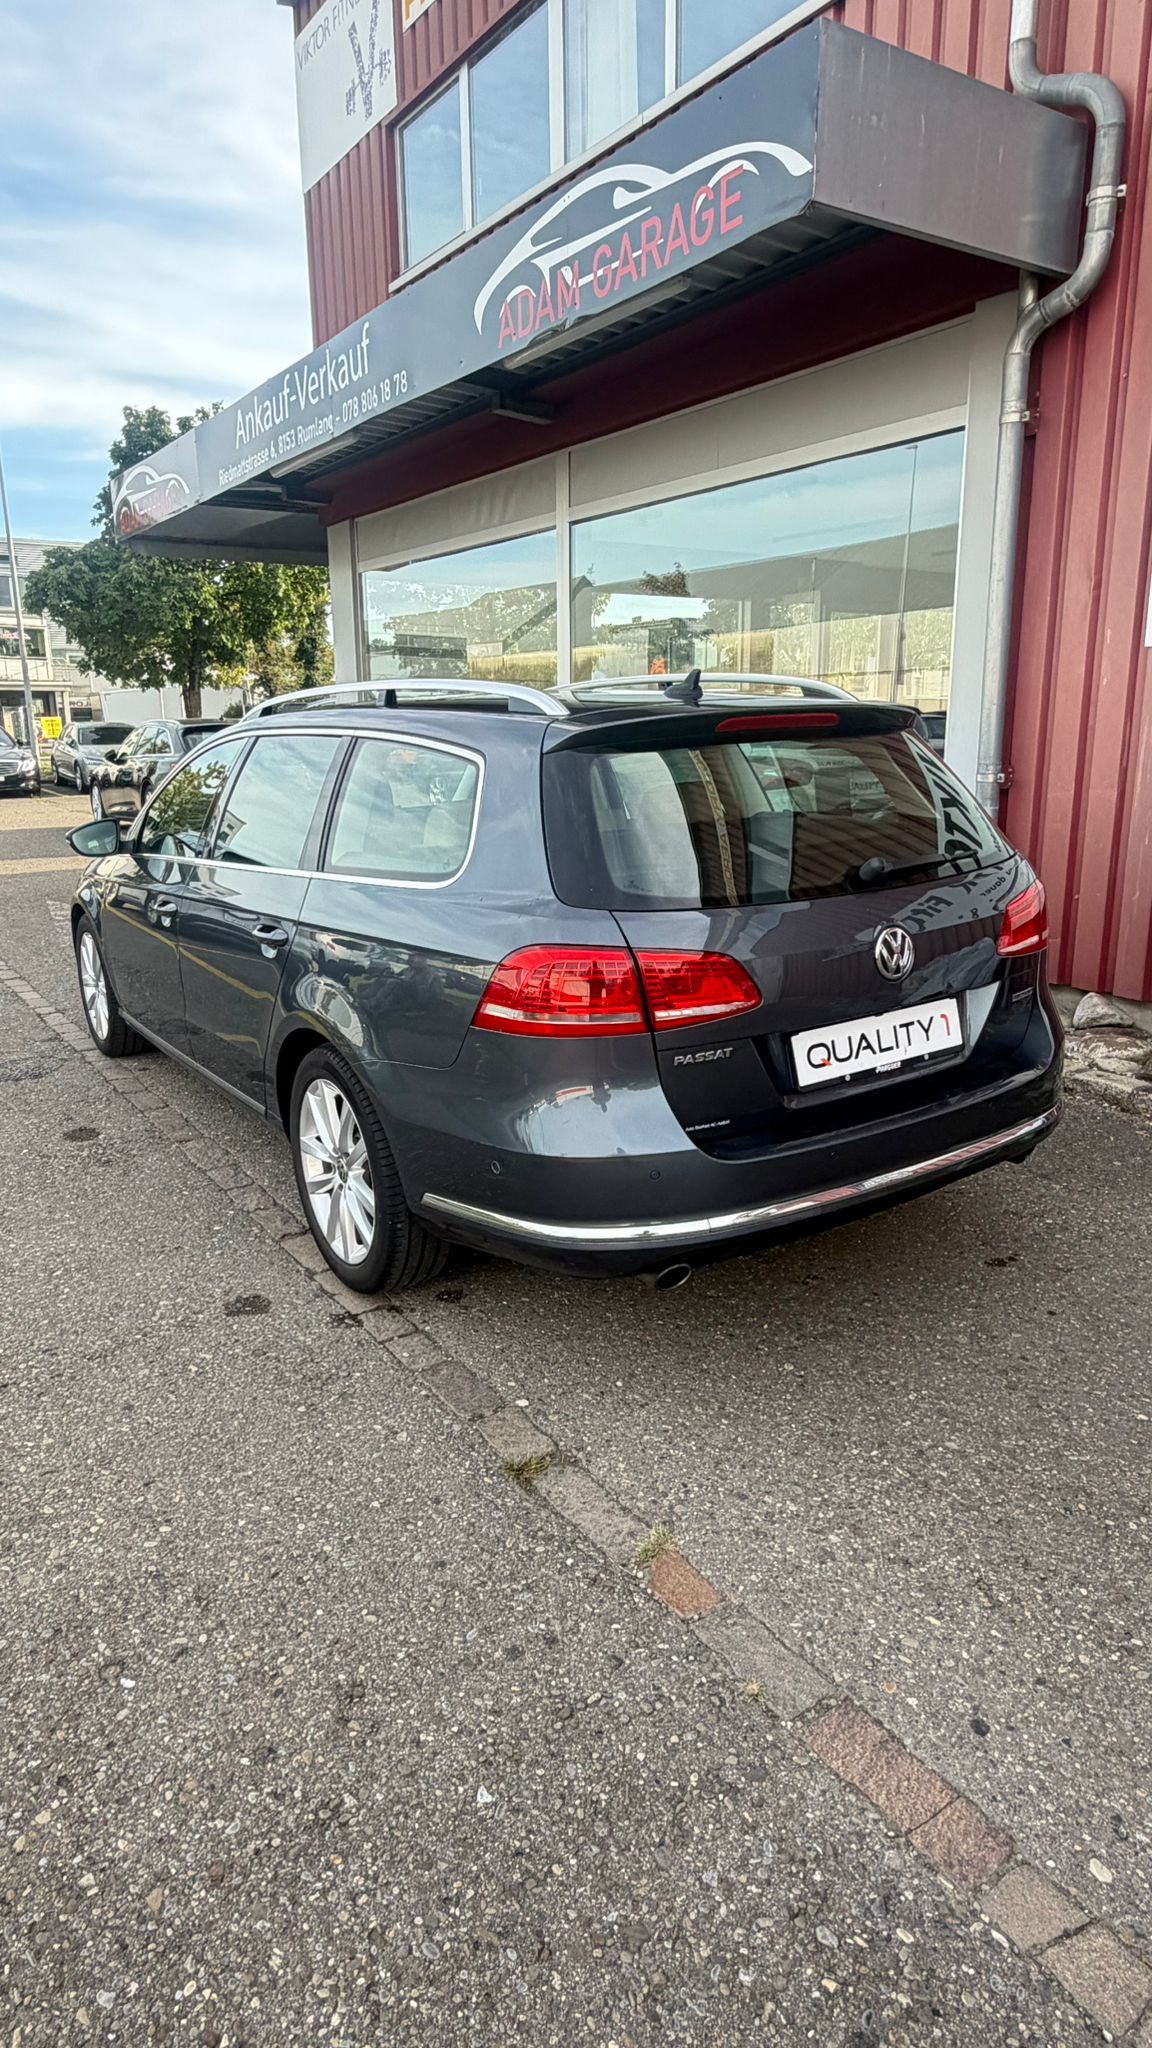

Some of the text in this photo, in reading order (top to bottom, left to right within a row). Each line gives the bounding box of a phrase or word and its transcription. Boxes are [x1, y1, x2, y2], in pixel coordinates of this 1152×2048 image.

[297, 17, 331, 69] VIKTOR
[498, 164, 745, 349] ADAM GARAGE
[235, 321, 370, 449] Ankauf-Verkauf
[278, 429, 295, 454] 8153
[342, 396, 359, 422] 078
[361, 385, 378, 413] 806
[380, 378, 391, 403] 18
[393, 370, 408, 396] 78
[674, 1047, 733, 1066] PASSAT
[806, 1015, 934, 1070] QUALITY
